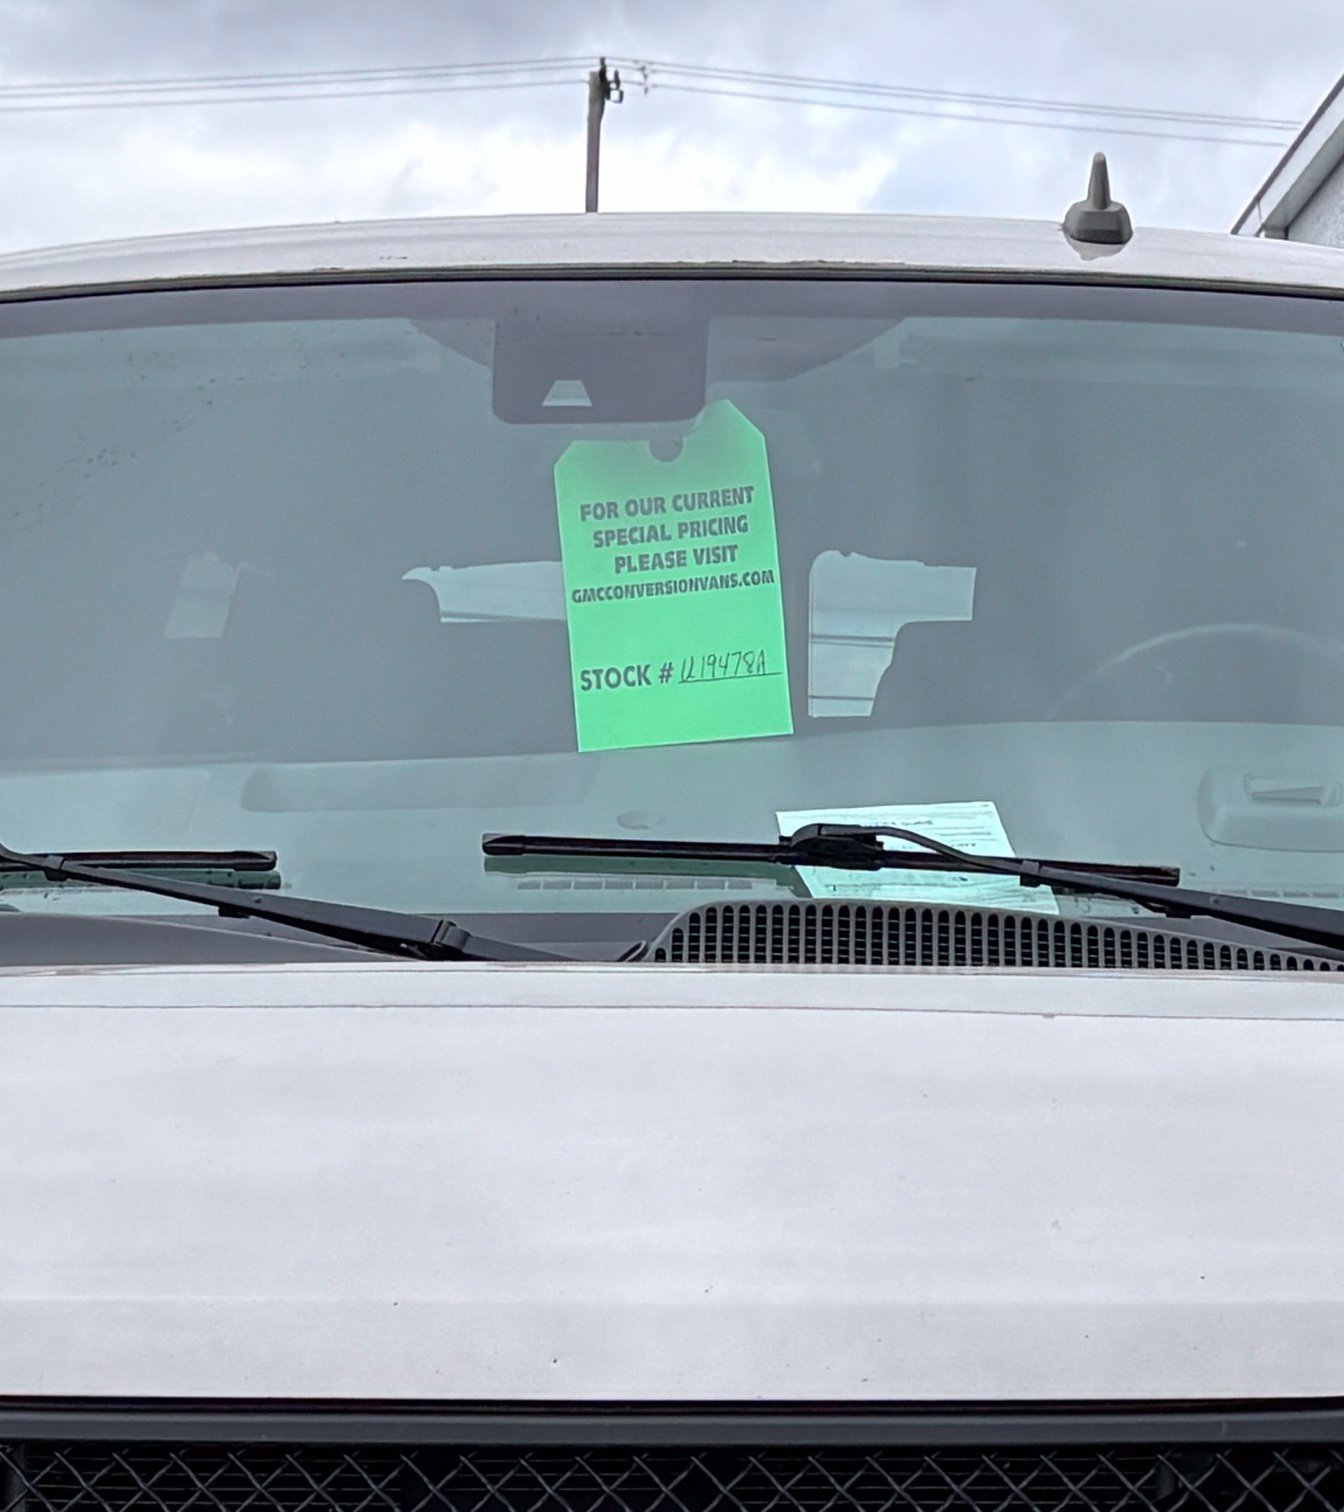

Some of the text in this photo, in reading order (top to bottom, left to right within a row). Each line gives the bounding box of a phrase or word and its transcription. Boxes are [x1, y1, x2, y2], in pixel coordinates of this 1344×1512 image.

[579, 485, 755, 522] FOR OUR CURRENT
[592, 514, 749, 548] SPECIAL PRICING
[614, 544, 739, 574] PLEASE VISIT
[571, 569, 776, 604] GMCCONVERSIONVANS.COM
[580, 662, 674, 691] STOCK #
